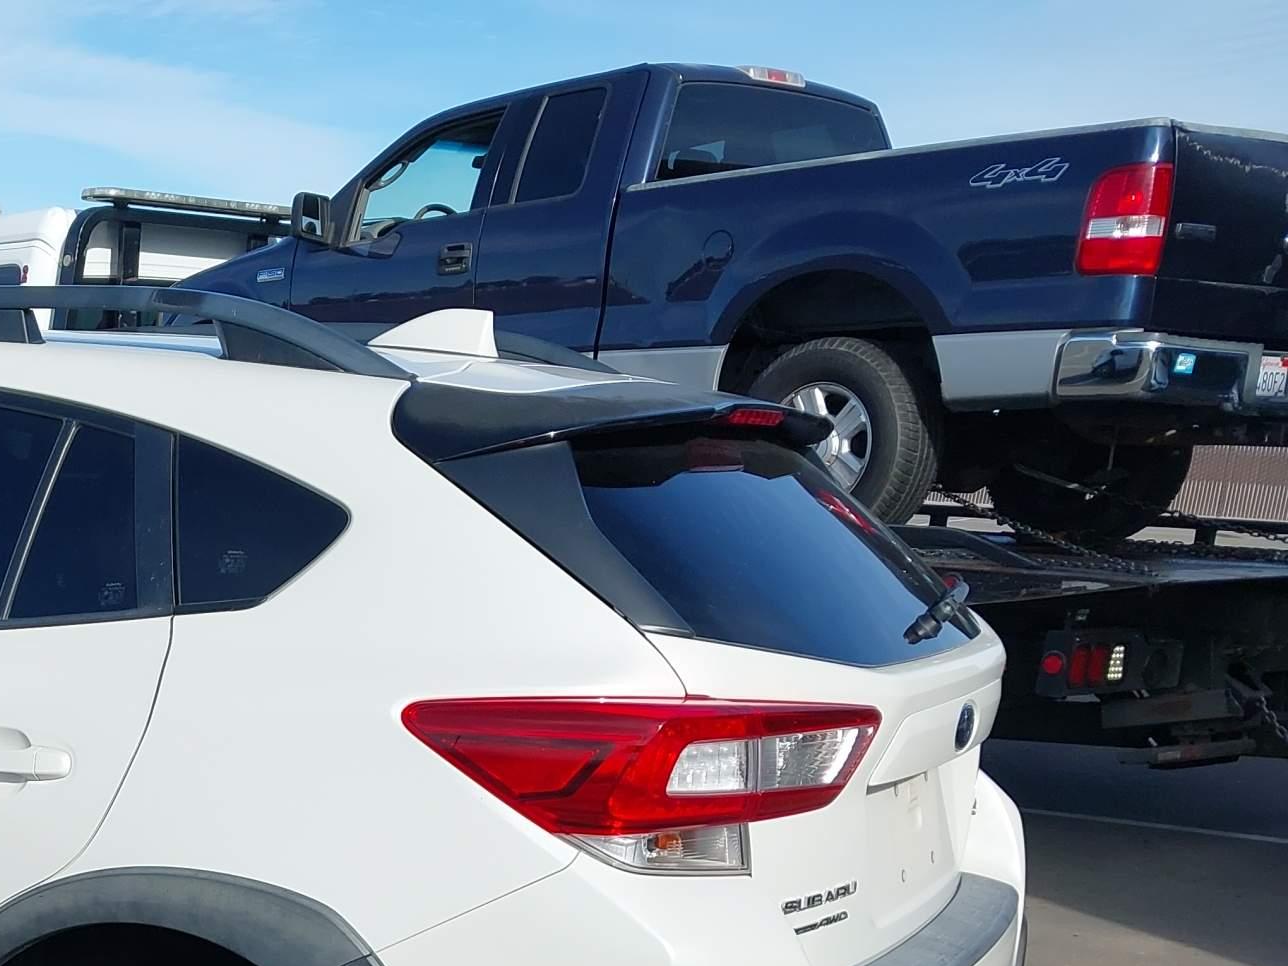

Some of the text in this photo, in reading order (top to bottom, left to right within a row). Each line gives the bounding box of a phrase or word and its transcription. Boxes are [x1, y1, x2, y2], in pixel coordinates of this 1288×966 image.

[969, 157, 1070, 188] 4x4
[781, 880, 858, 915] SUBARU
[817, 910, 849, 928] AWD
